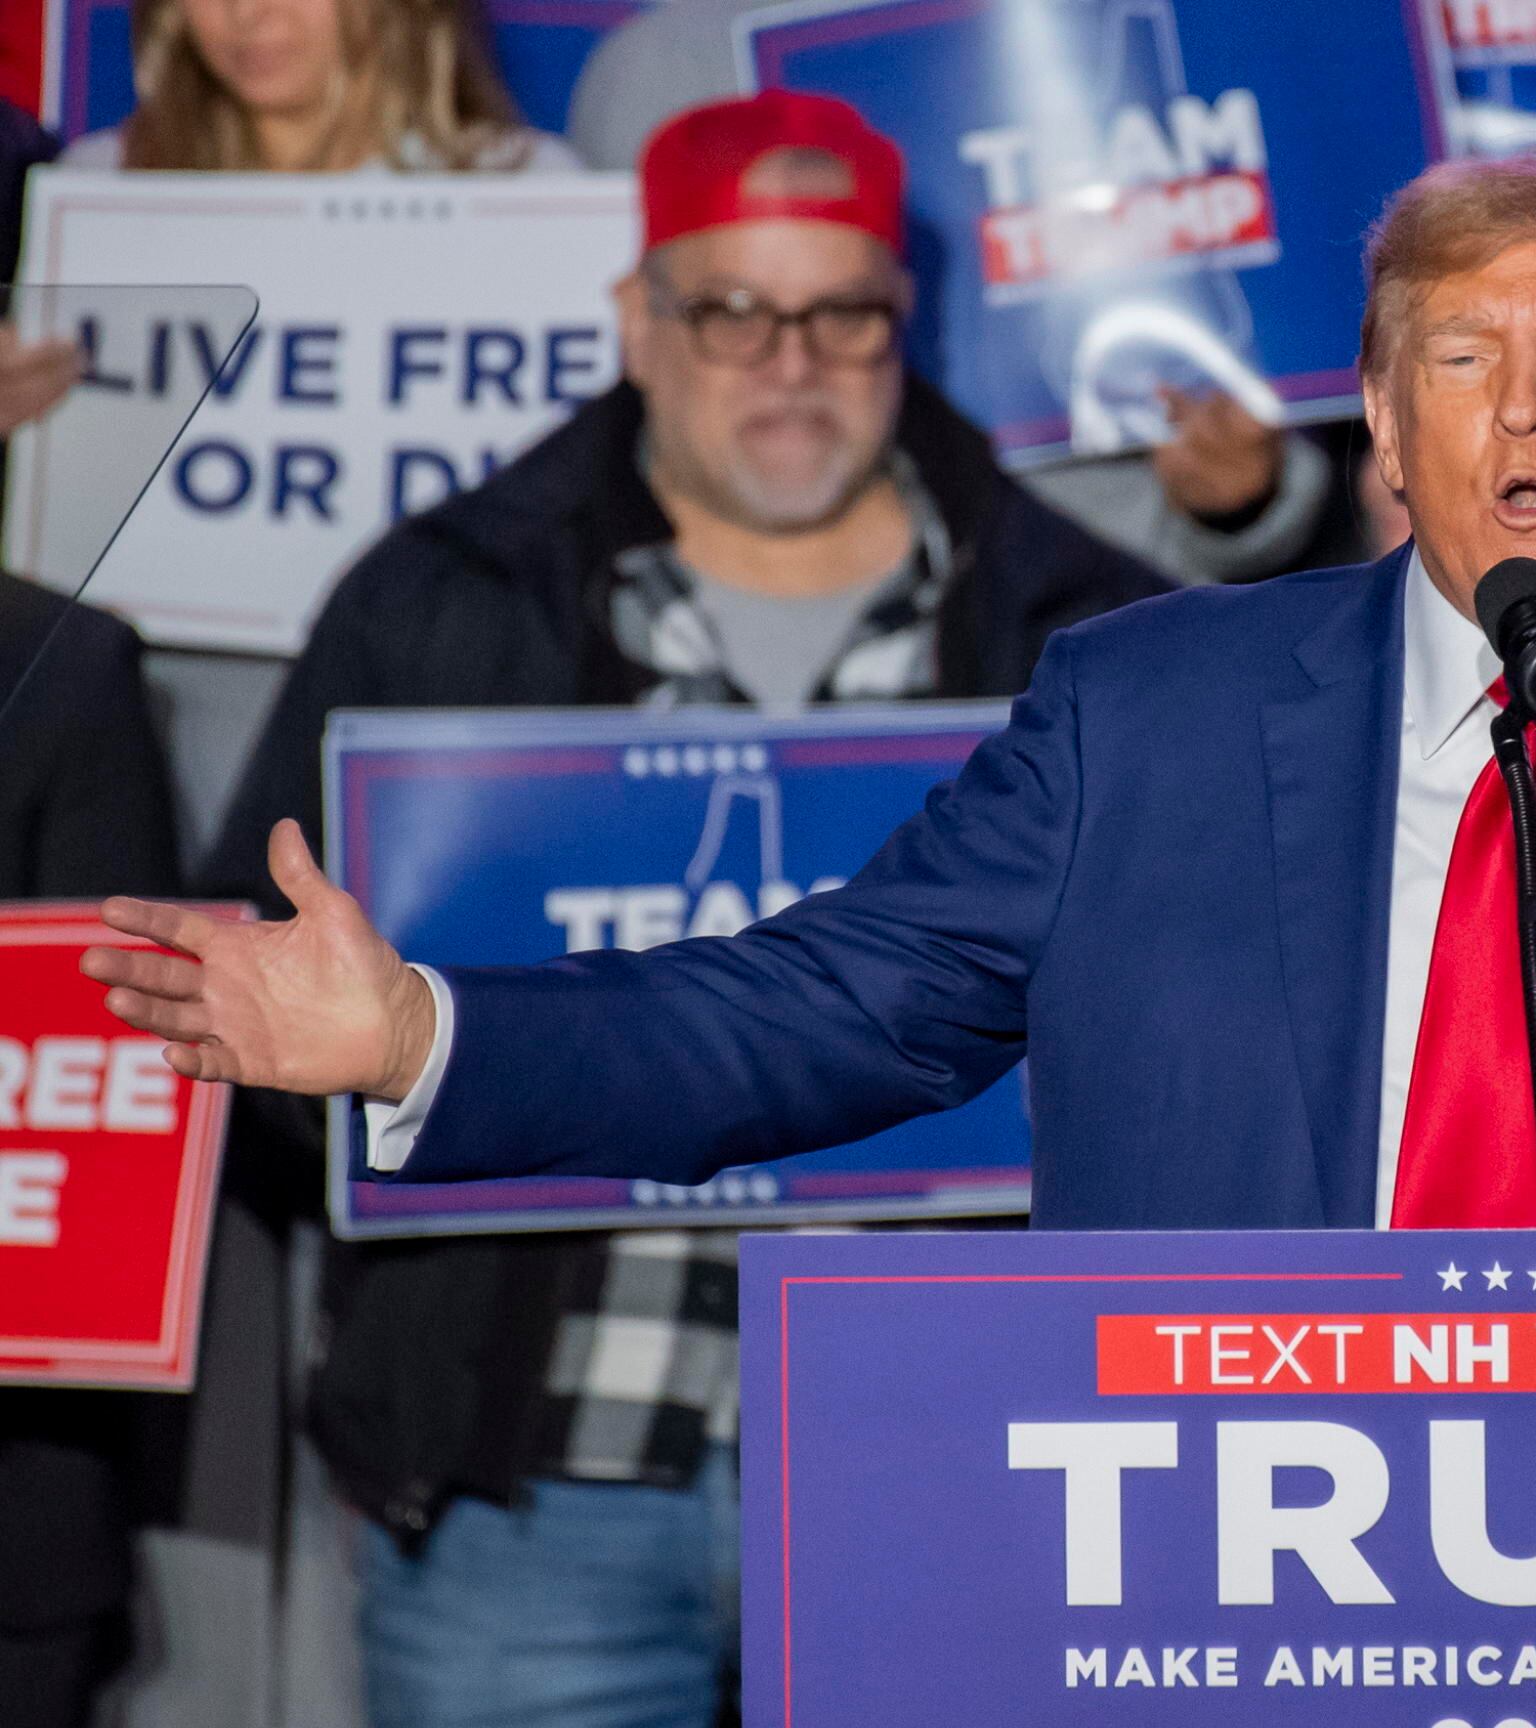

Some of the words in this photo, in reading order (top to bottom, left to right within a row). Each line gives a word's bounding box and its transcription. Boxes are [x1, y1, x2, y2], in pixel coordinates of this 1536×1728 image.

[81, 306, 338, 405] LIVE
[389, 326, 600, 405] FRE
[174, 441, 340, 519] OR
[546, 877, 847, 952] TEA
[1155, 1325, 1364, 1385] TEXT
[1393, 1323, 1510, 1384] NH
[1065, 1647, 1239, 1688] MAKE
